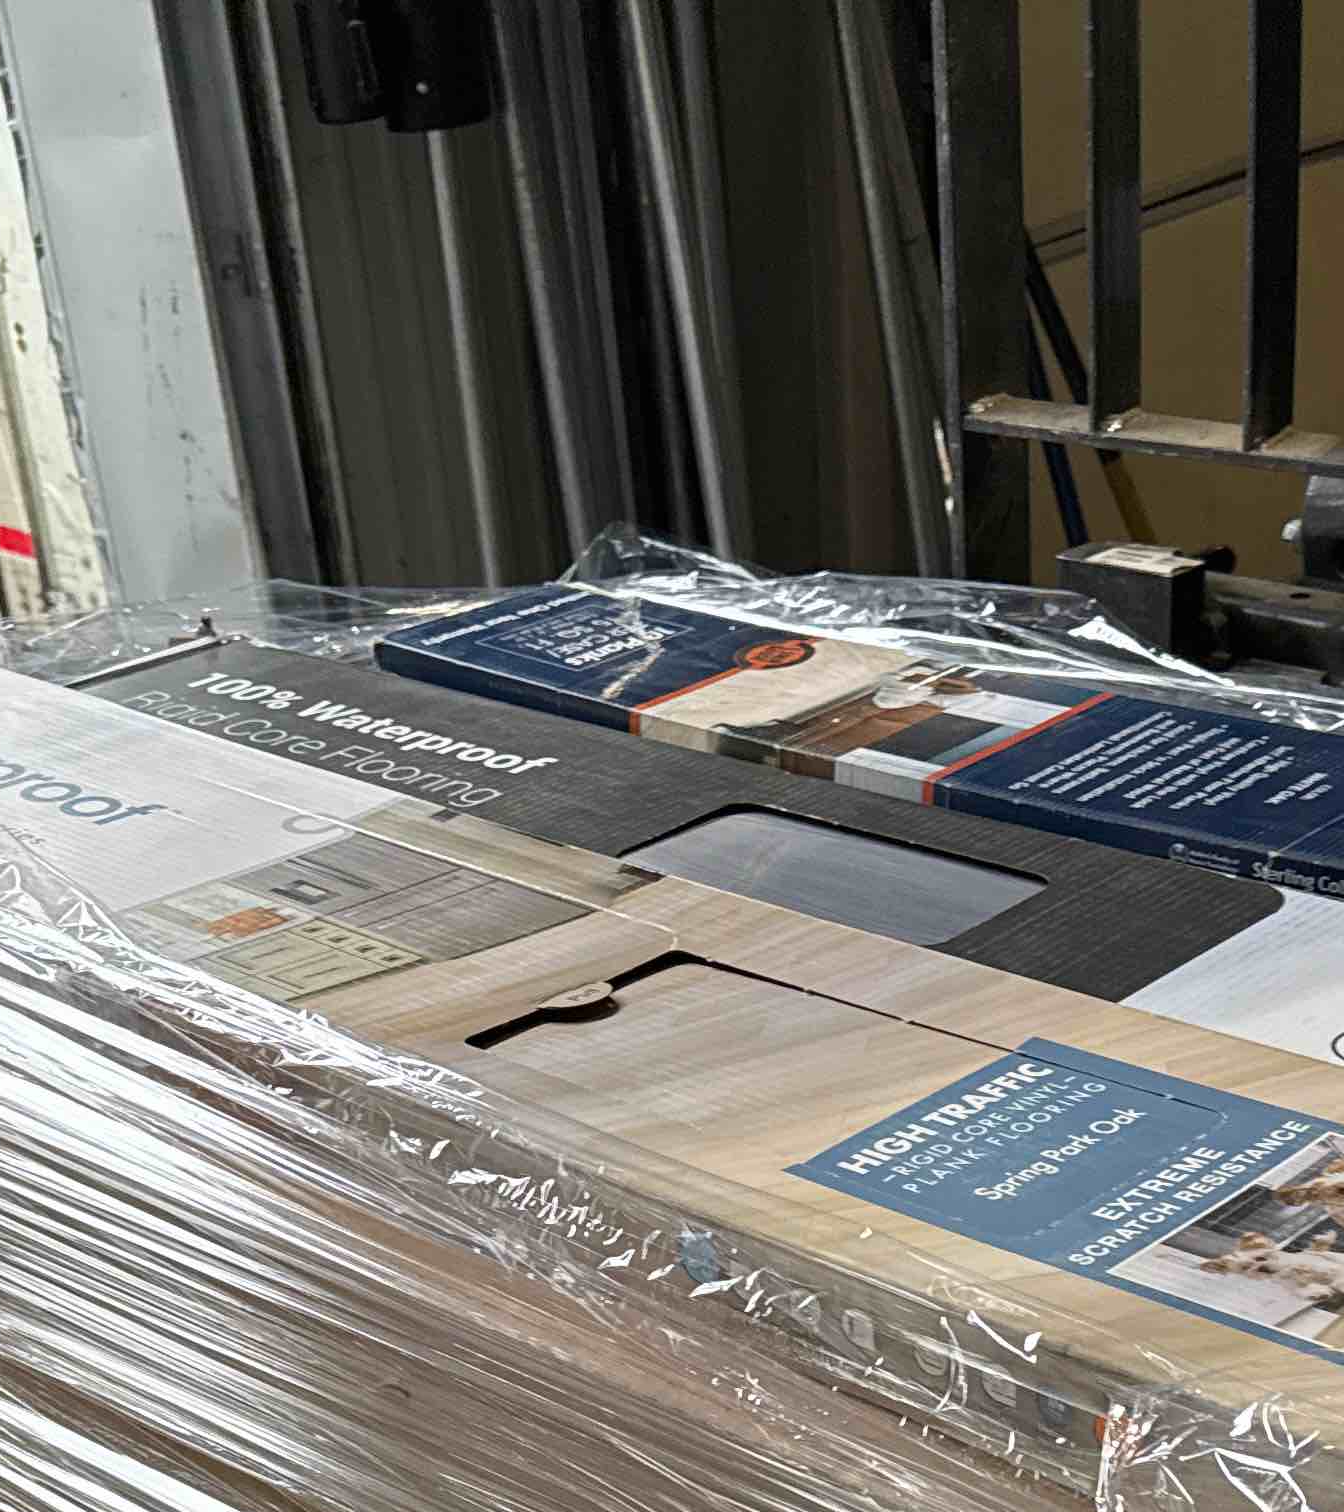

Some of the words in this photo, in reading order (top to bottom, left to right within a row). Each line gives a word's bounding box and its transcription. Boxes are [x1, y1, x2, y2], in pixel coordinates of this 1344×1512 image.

[120, 690, 243, 729] Rigid
[224, 717, 327, 756] Core
[319, 744, 505, 808] Flooring
[187, 672, 304, 711] 100%
[297, 700, 560, 776] Waterproof
[1250, 860, 1316, 893] Sterling
[837, 1121, 938, 1177] HIGH
[924, 1062, 1054, 1137] TRAFFIC
[904, 1149, 981, 1195] PLANK
[990, 1081, 1108, 1148] FLOORING
[953, 1111, 1011, 1145] CORE
[973, 1147, 1064, 1204] Spring
[1052, 1126, 1101, 1165] Park
[1096, 1103, 1148, 1138] Oak
[1068, 1196, 1181, 1269] SCRATCH
[1175, 1118, 1313, 1205] RESISTANCE
[1093, 1144, 1227, 1222] EXTREME
